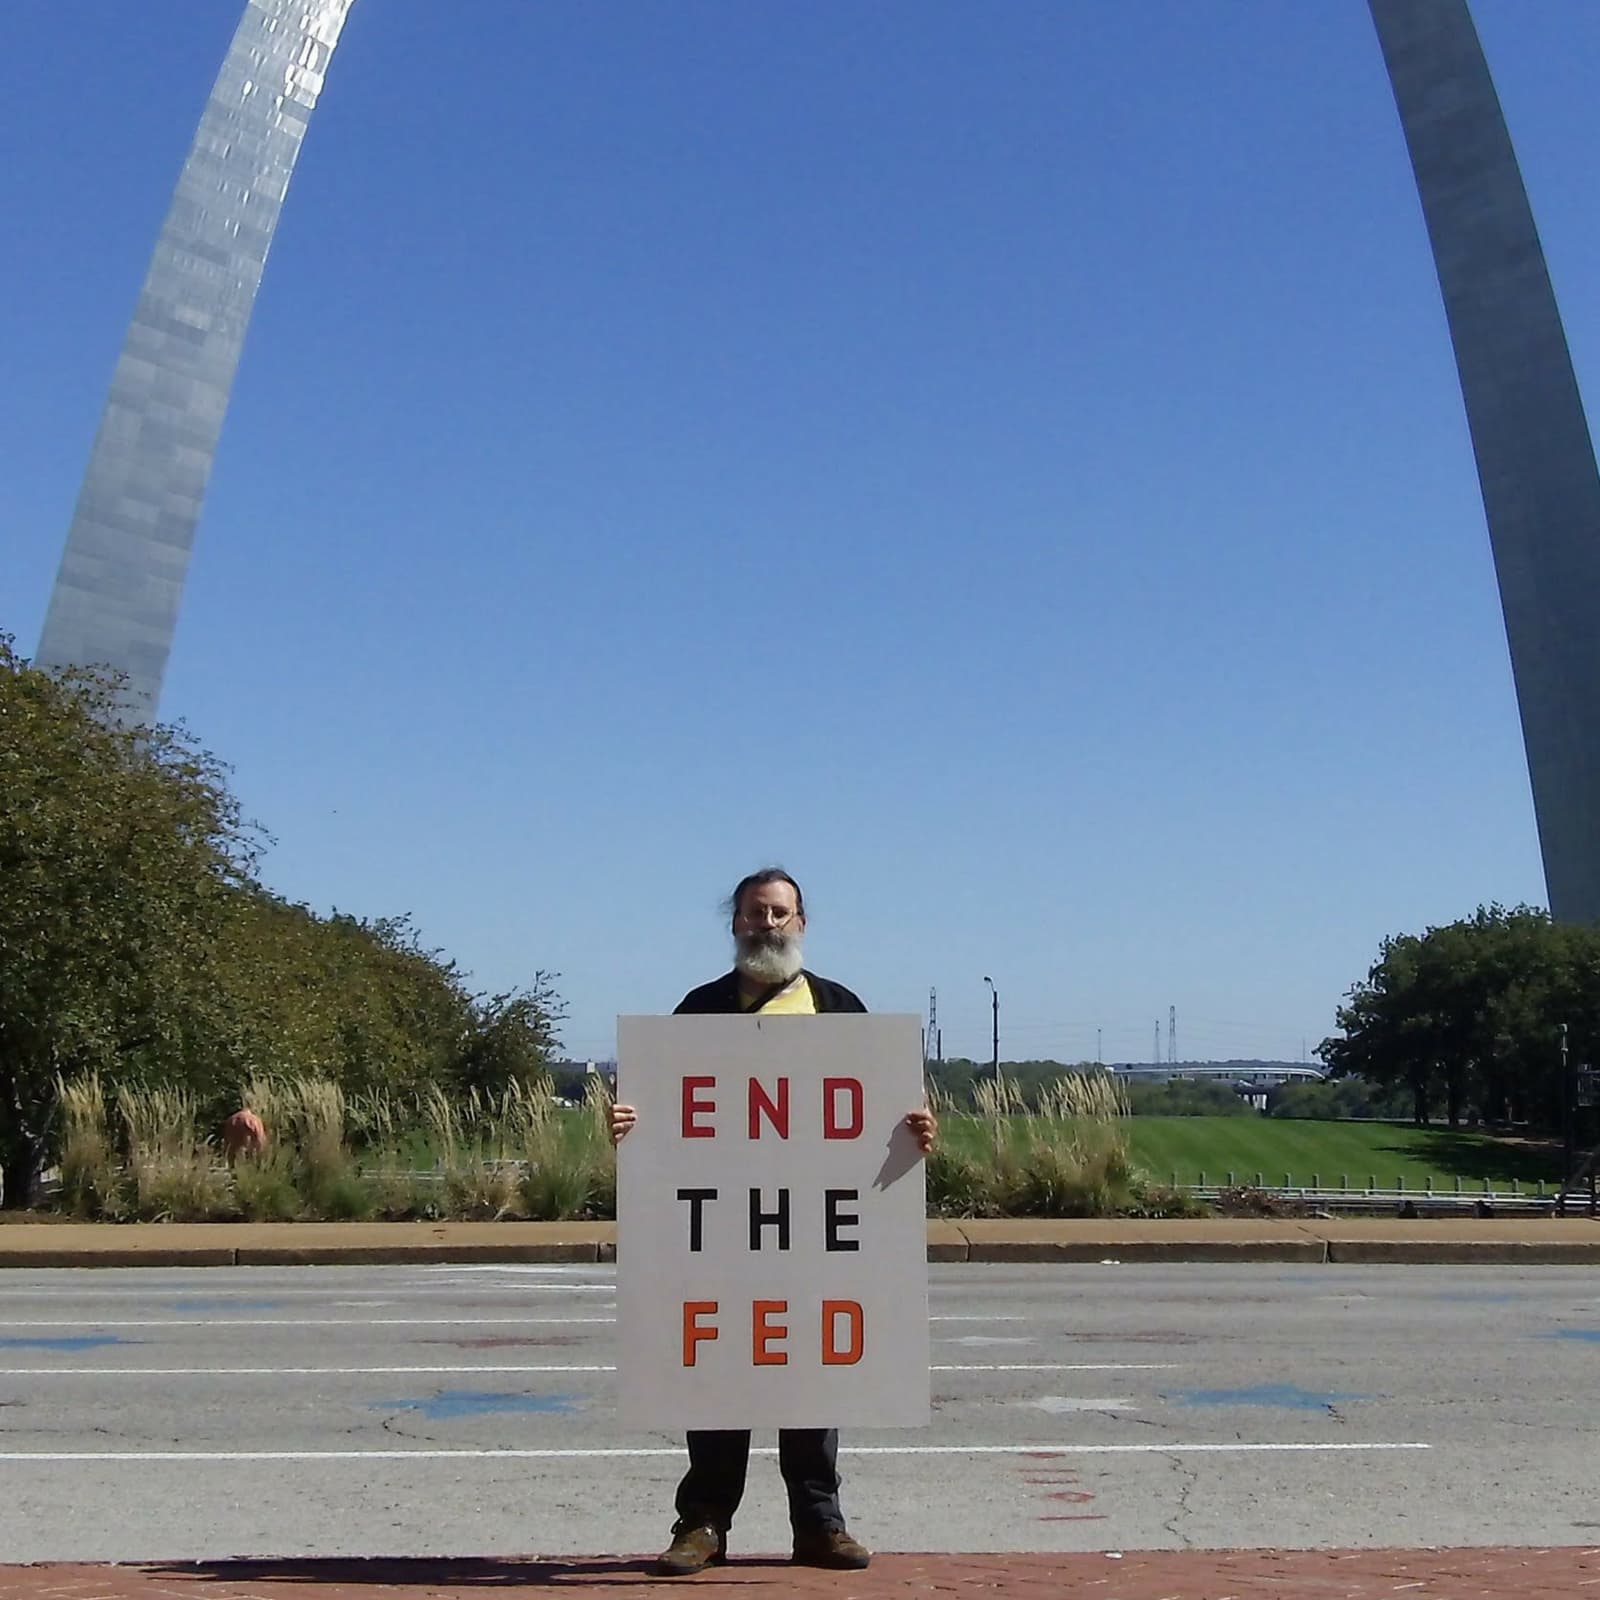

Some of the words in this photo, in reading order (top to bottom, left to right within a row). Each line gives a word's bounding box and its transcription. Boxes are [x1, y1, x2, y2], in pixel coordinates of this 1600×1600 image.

[681, 1075, 864, 1140] END
[676, 1187, 860, 1252] THE
[682, 1299, 865, 1367] FED
